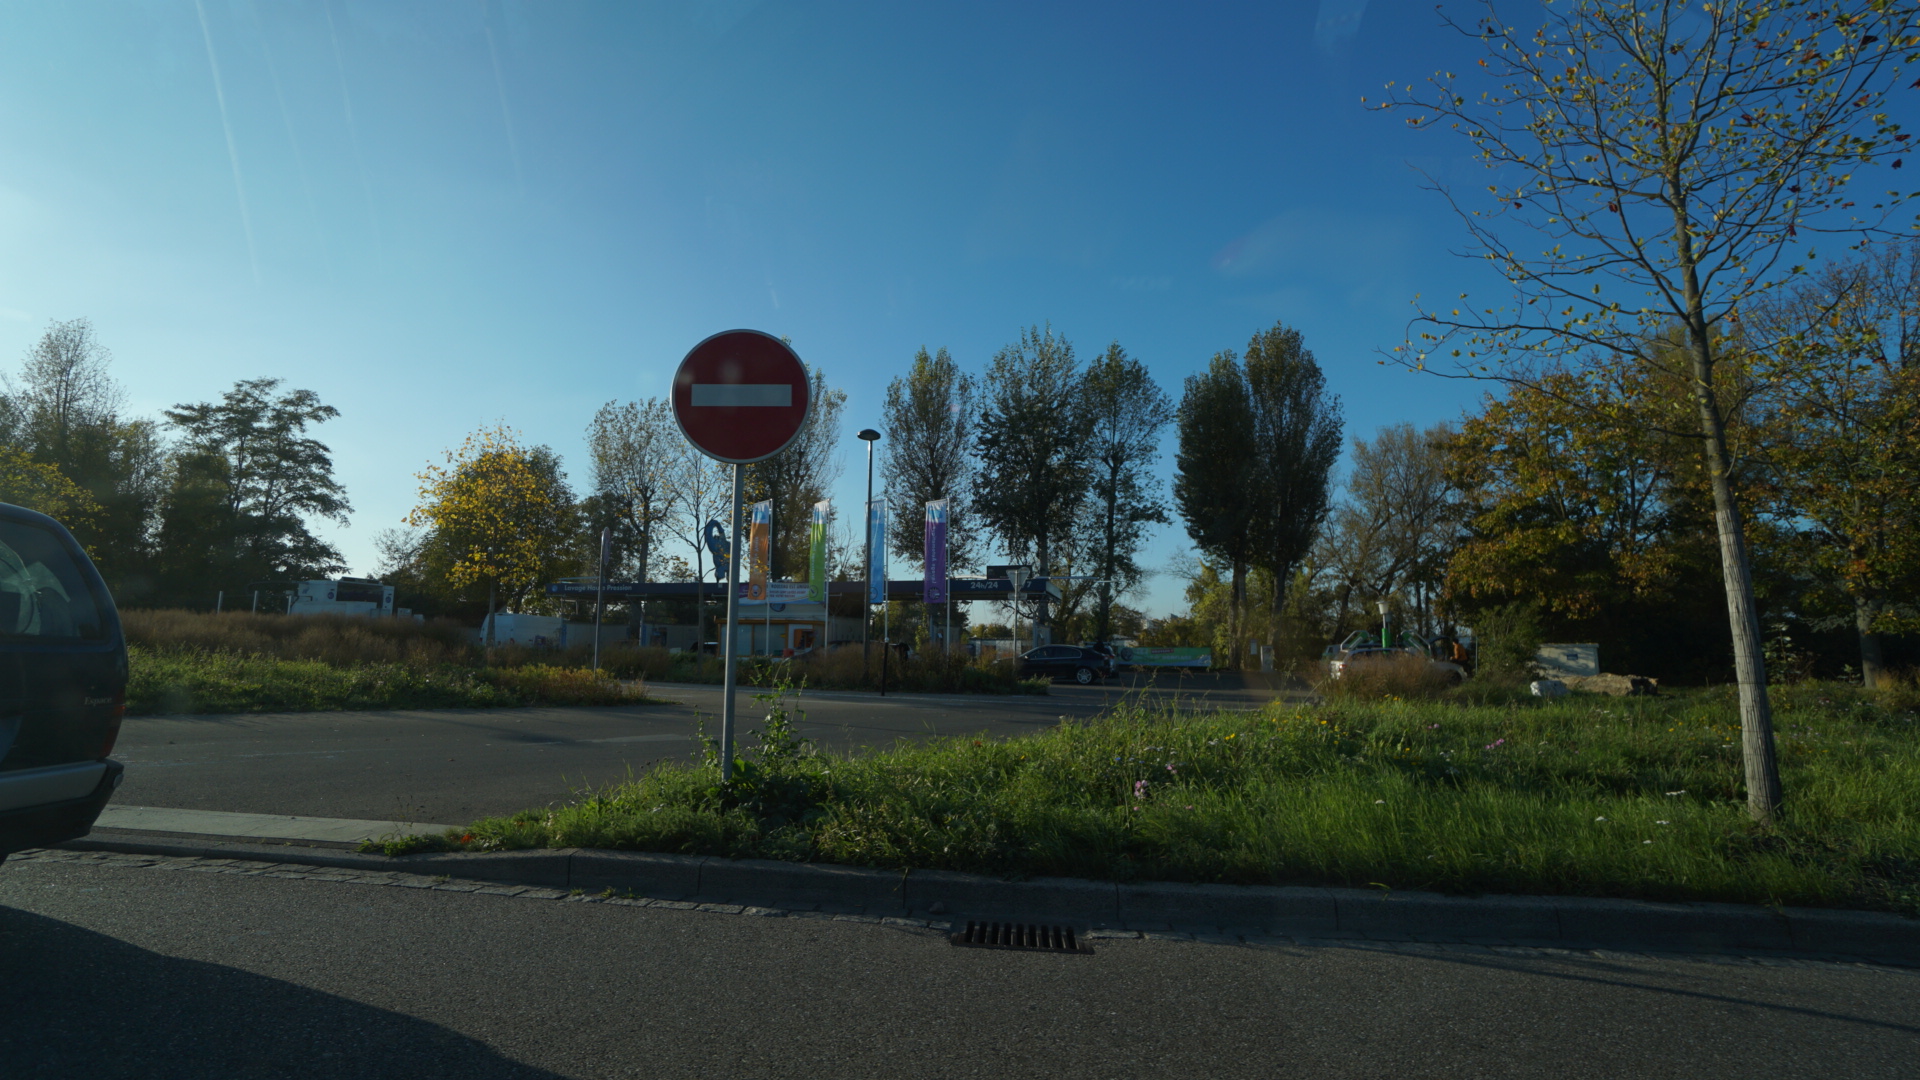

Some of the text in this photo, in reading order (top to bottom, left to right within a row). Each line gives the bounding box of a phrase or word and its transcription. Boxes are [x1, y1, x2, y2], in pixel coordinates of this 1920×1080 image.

[564, 585, 586, 593] Lavage
[970, 581, 999, 589] 24h/24
[84, 696, 113, 707] Espace
